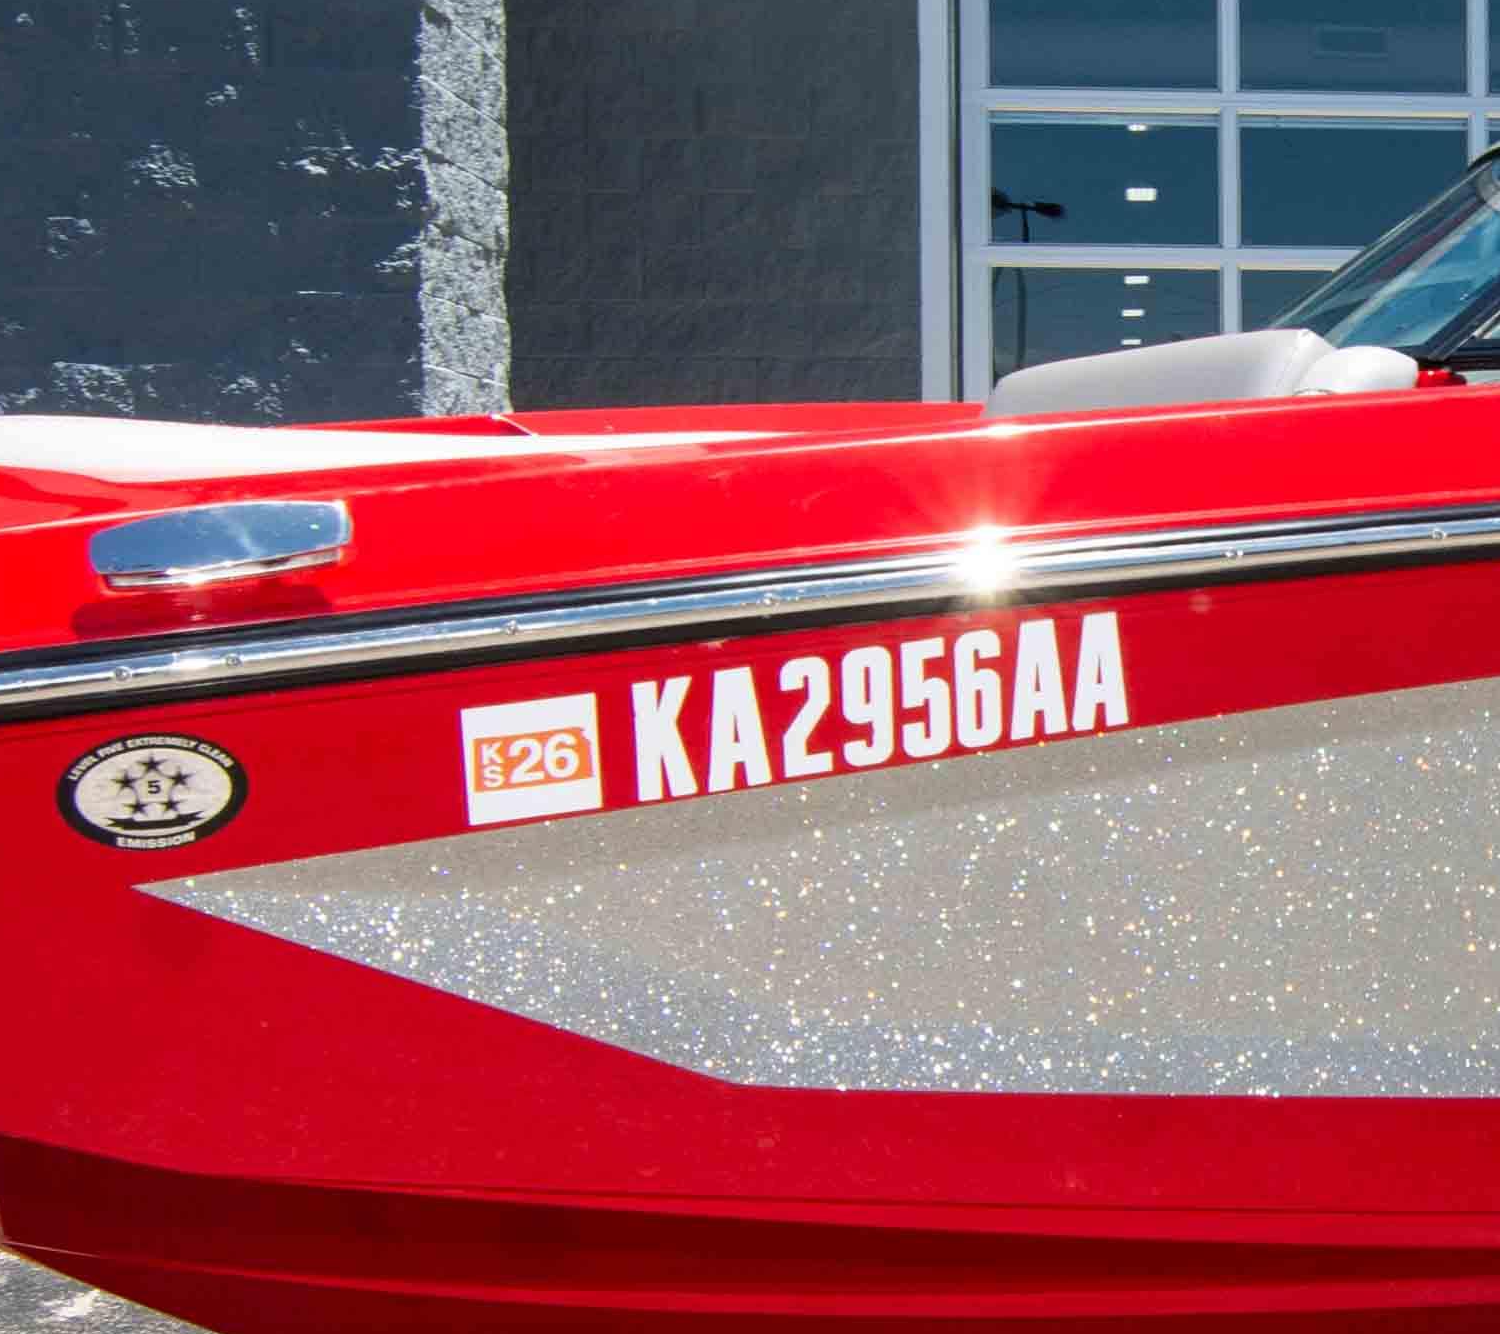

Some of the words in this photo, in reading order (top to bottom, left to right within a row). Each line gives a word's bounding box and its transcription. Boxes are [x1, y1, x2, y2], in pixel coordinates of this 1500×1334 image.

[630, 610, 1130, 803] KA2956AA
[507, 731, 581, 783] 26
[147, 779, 161, 795] 5
[115, 831, 196, 849] EMISSION
